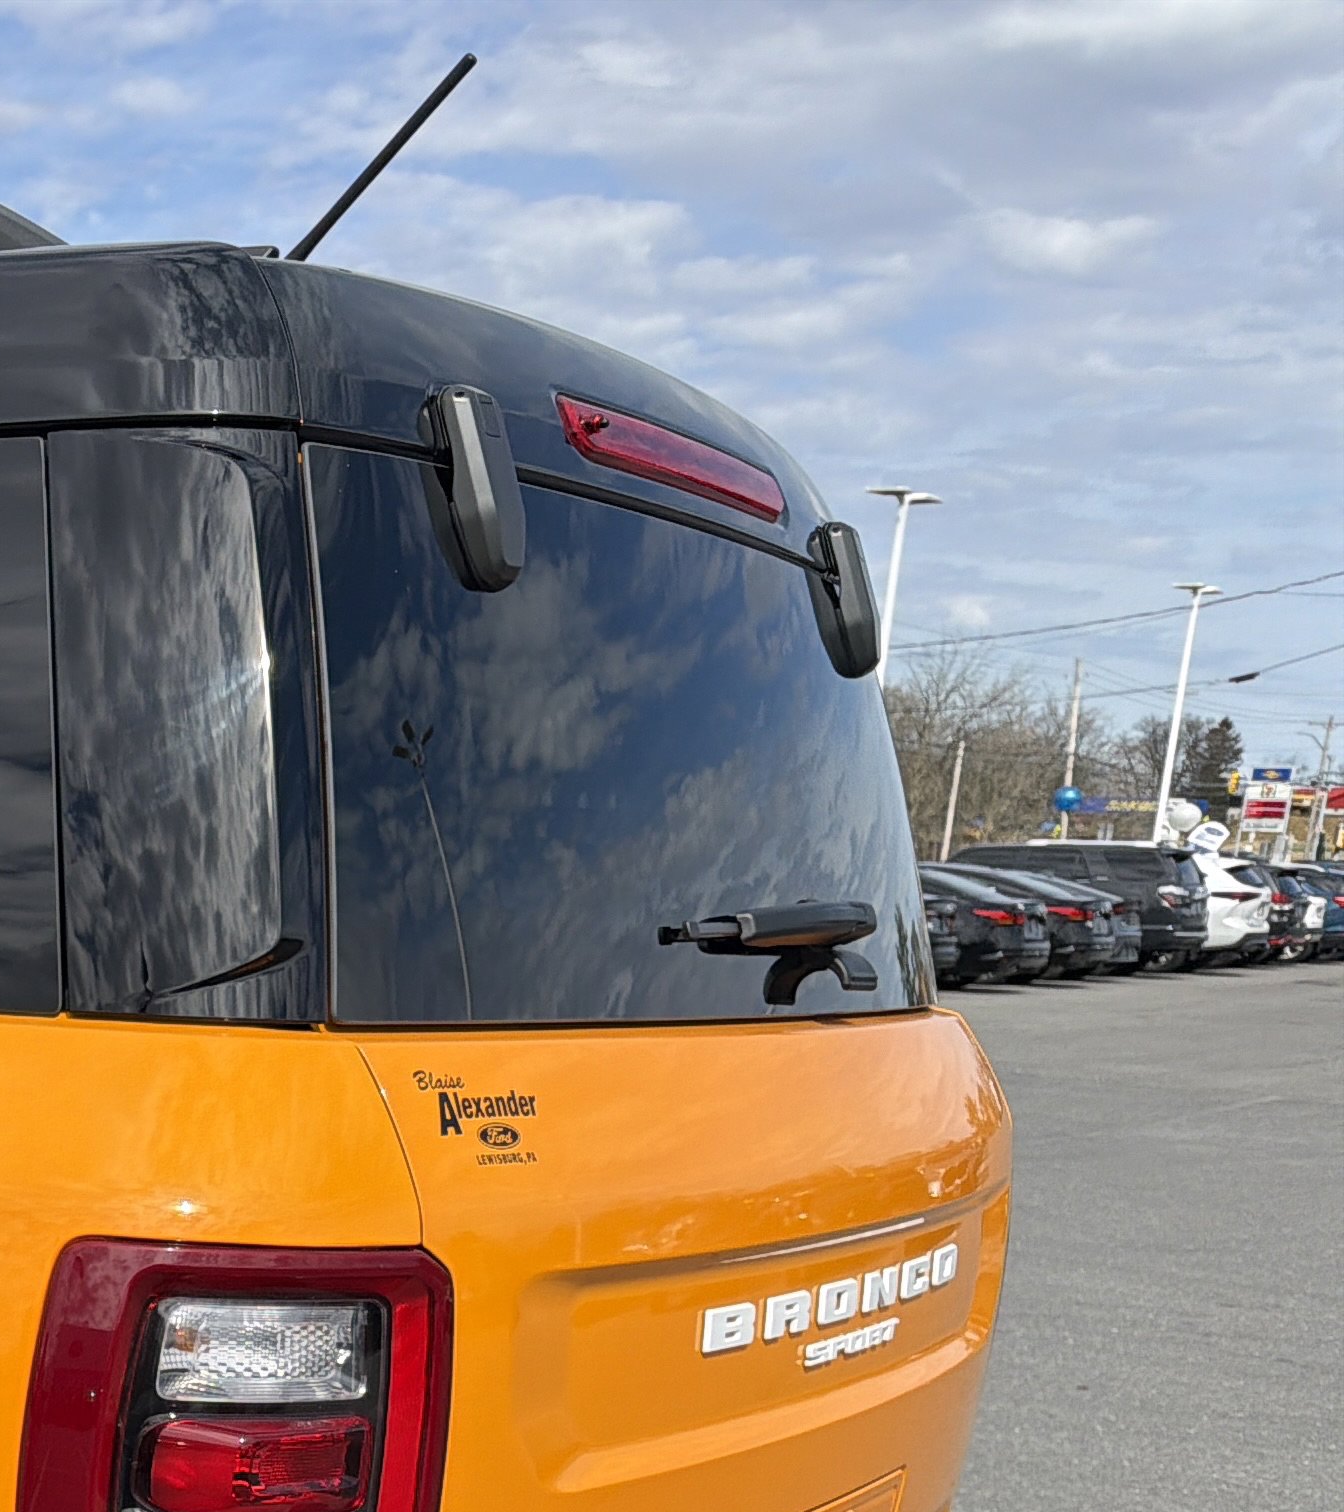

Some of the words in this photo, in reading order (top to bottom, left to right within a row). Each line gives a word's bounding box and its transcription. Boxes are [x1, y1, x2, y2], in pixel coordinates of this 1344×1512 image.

[412, 1069, 465, 1091] Blaise
[437, 1089, 537, 1137] Alexander
[486, 1127, 514, 1145] Ford
[701, 1243, 959, 1354] BRONCO
[803, 1318, 900, 1367] SPORT
